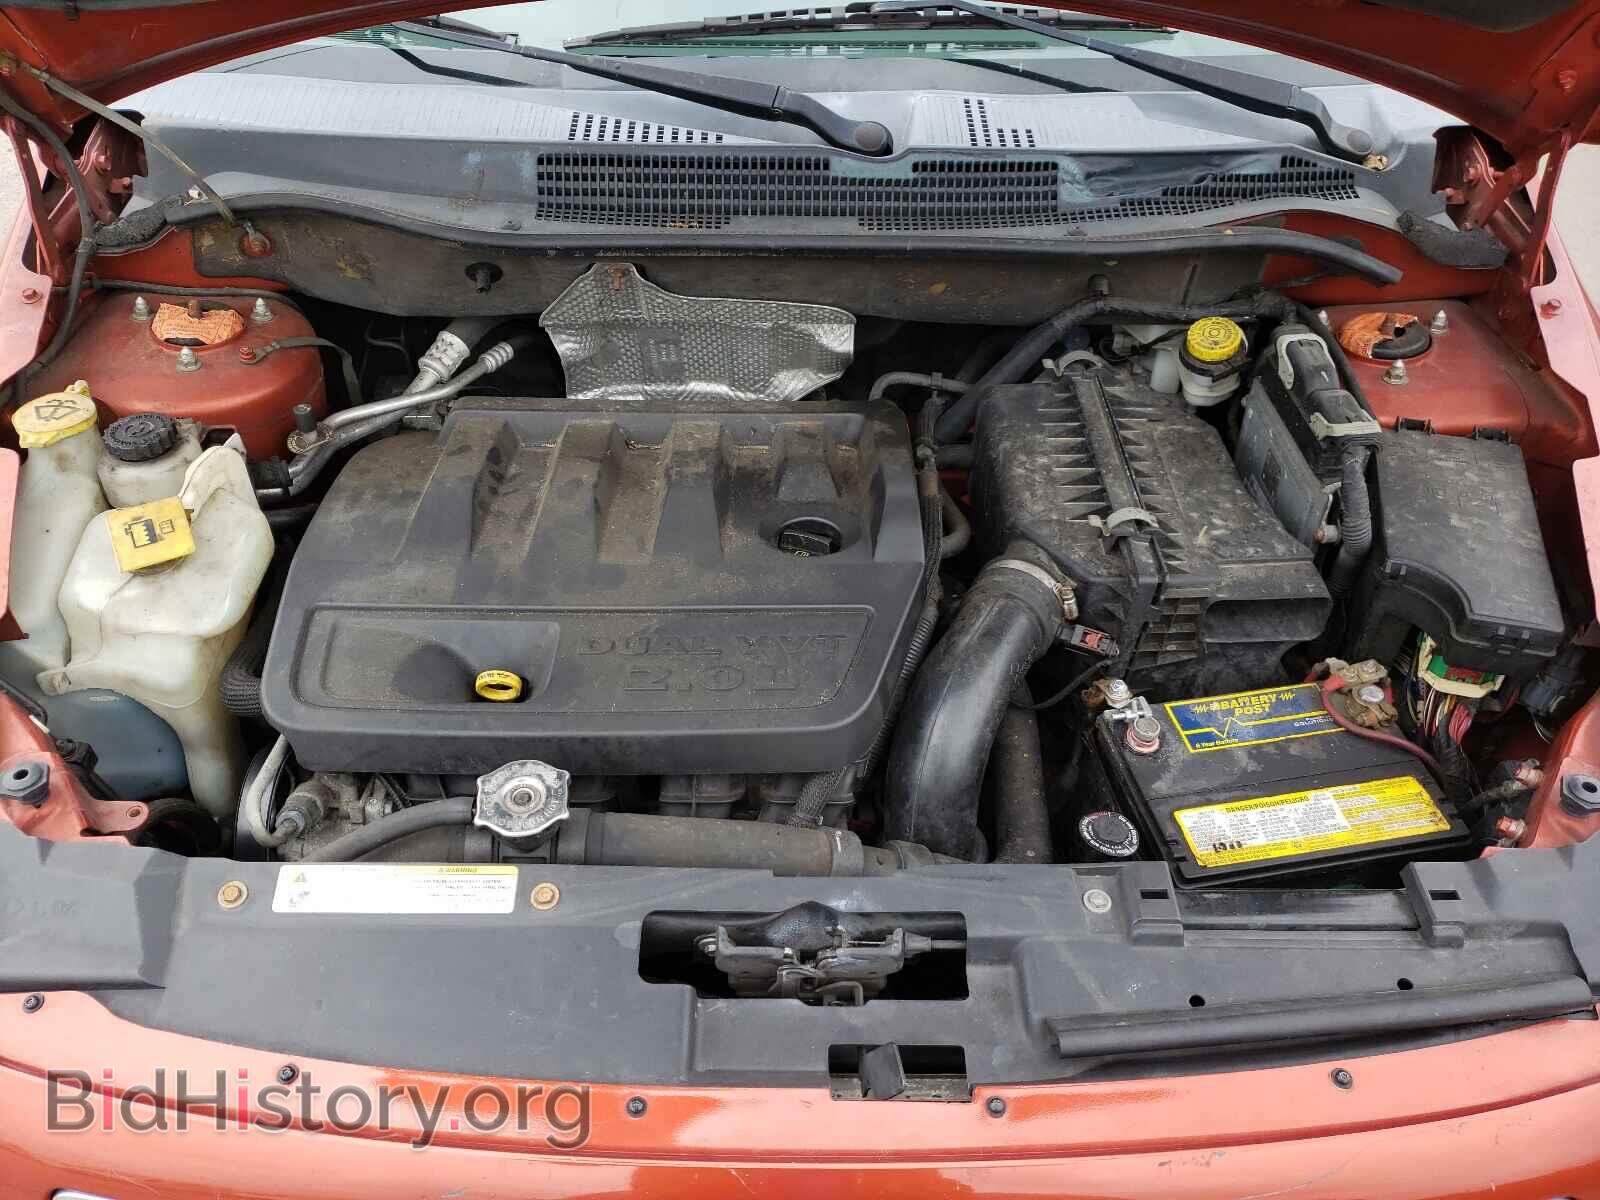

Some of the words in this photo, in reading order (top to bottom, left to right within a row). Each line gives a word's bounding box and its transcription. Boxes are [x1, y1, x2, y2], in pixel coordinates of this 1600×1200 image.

[577, 634, 722, 656] DUAL
[623, 664, 798, 692] 2.0L
[1220, 694, 1277, 710] BATTERY
[1234, 703, 1271, 715] POST
